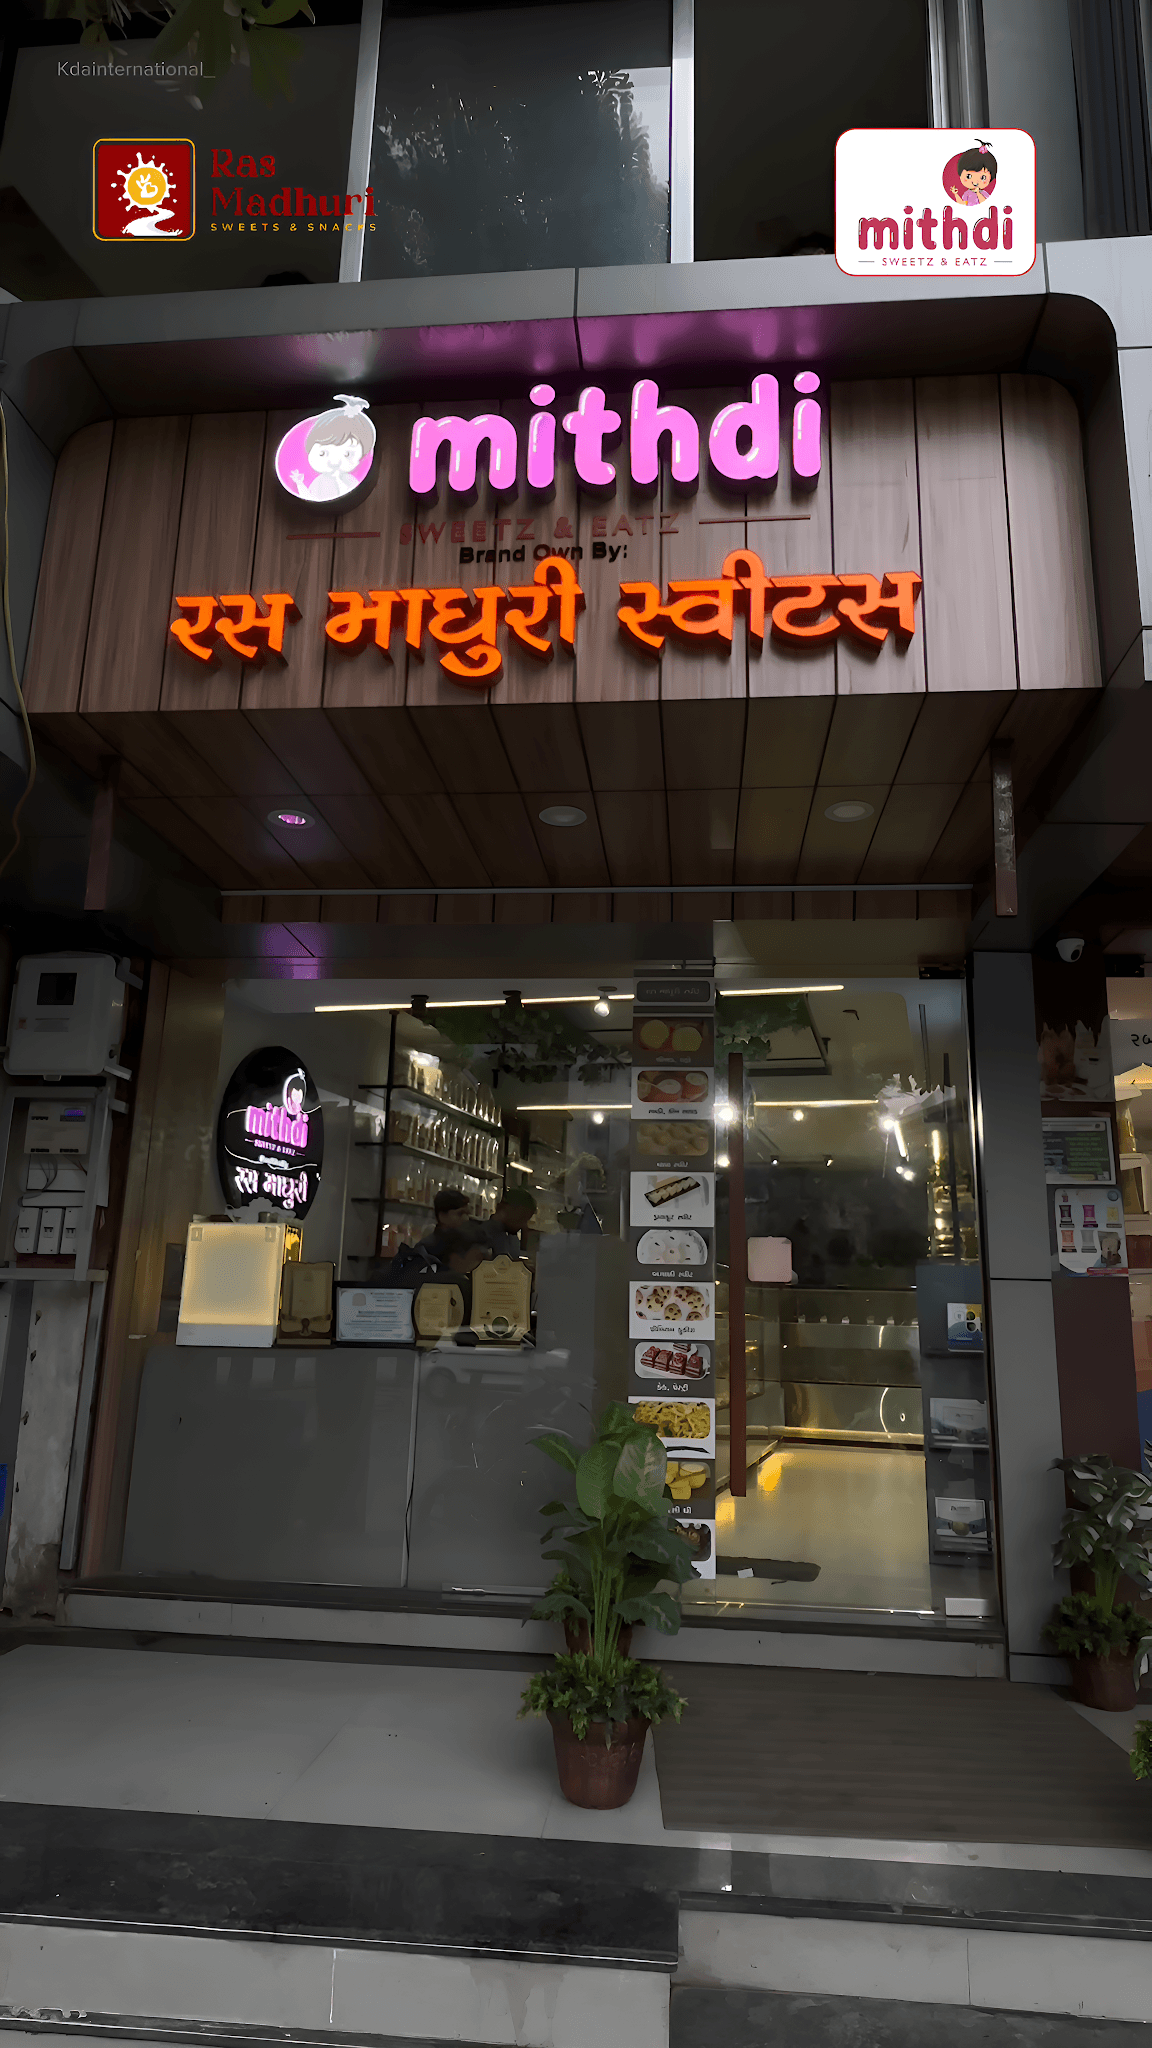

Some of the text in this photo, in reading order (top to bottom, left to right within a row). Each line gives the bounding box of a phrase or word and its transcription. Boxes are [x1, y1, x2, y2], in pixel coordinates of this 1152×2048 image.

[409, 370, 822, 494] mithdi
[399, 512, 680, 546] SWEETZ & EATZ
[459, 544, 526, 564] Brand
[532, 543, 583, 561] Own
[169, 592, 296, 661] रस
[234, 1166, 259, 1194] रस
